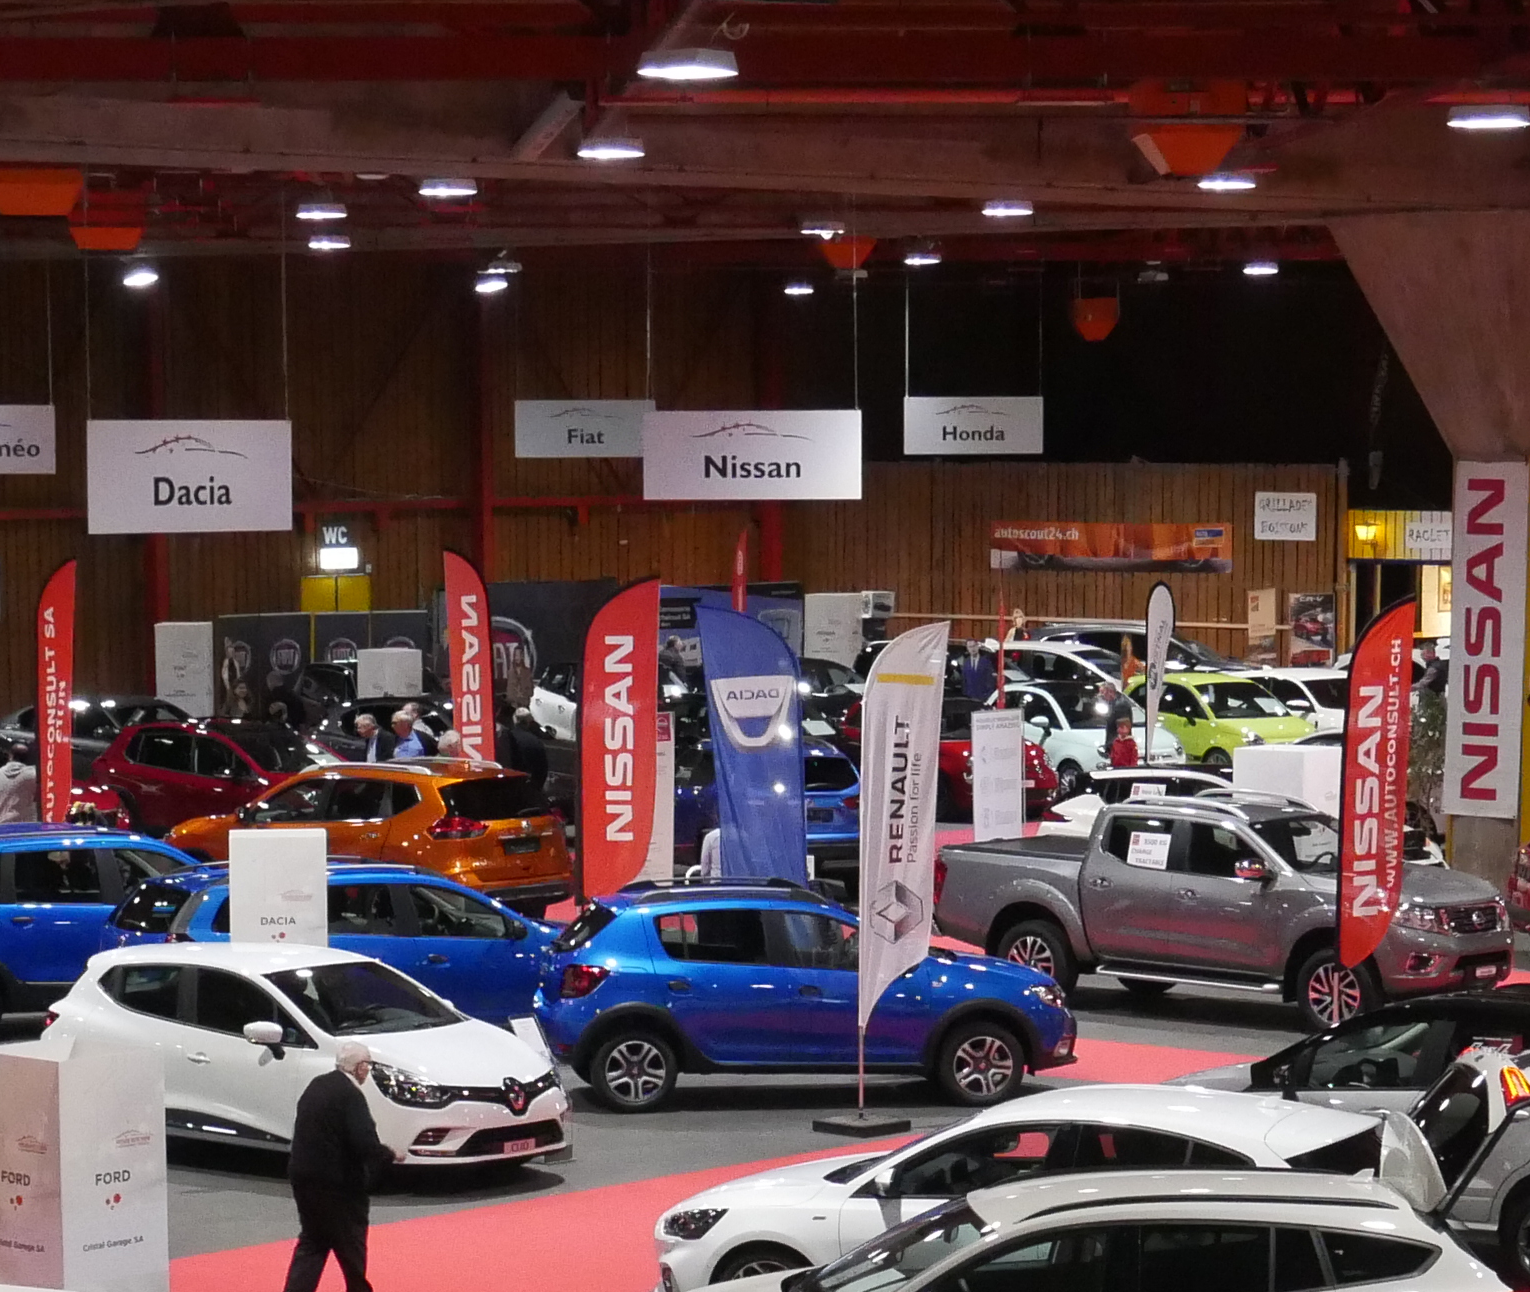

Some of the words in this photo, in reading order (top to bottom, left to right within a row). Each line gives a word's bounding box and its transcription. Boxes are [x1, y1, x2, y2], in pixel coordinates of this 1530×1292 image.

[567, 428, 605, 446] Fiat
[942, 424, 1006, 443] Honda
[703, 454, 802, 480] Nissan
[153, 475, 233, 507] Dacia
[323, 526, 348, 545] WC
[994, 526, 1080, 542] autoscout24.ch
[1459, 477, 1506, 801] NISSAN
[604, 634, 635, 843] NISSAN
[912, 752, 923, 782] life
[1380, 637, 1403, 890] WWW.AUTOCONSULT.CH
[888, 714, 911, 865] RENAULT
[910, 785, 920, 804] for
[1351, 684, 1386, 918] NISSAN
[906, 807, 921, 864] Passion
[260, 916, 297, 926] DACIA
[0, 1169, 31, 1187] FORD
[94, 1169, 131, 1187] FORD
[36, 1244, 46, 1253] SA
[82, 1240, 106, 1253] Cristal
[107, 1237, 132, 1250] Garage
[133, 1234, 145, 1244] SA
